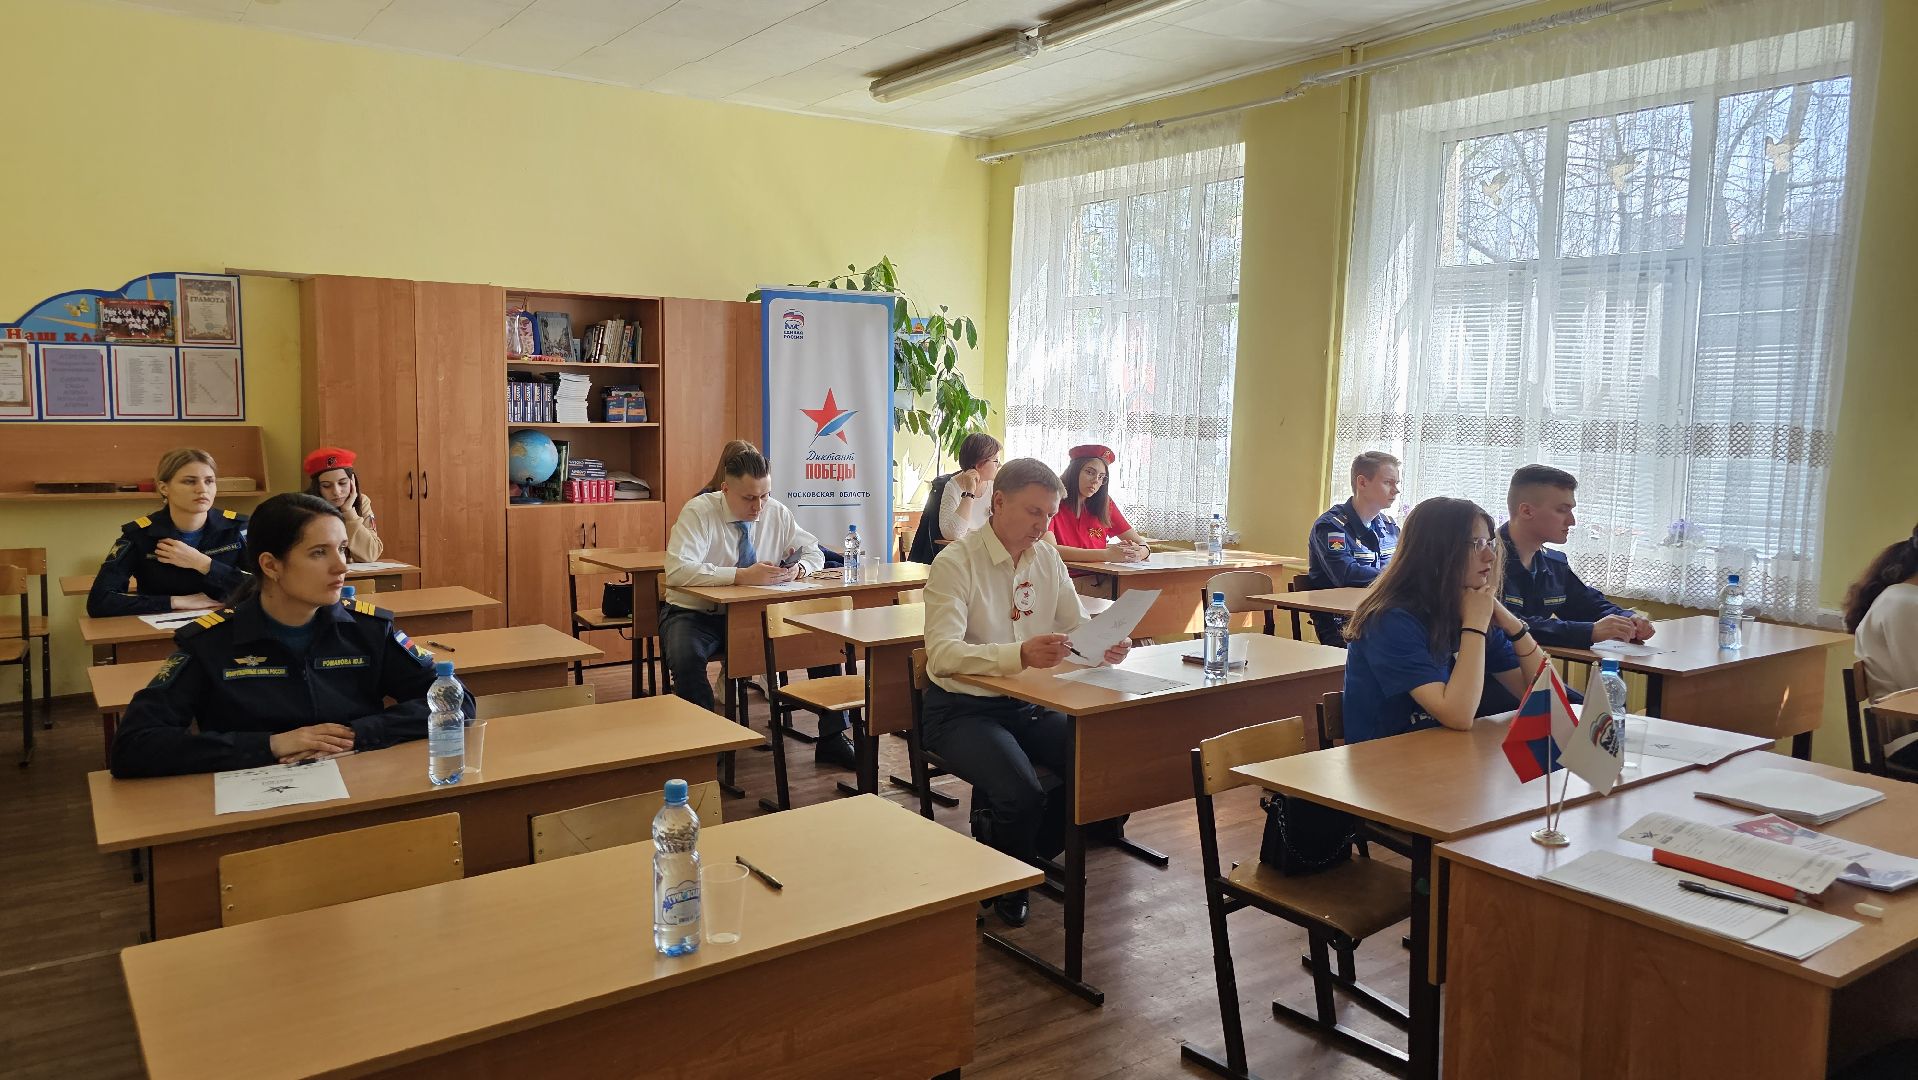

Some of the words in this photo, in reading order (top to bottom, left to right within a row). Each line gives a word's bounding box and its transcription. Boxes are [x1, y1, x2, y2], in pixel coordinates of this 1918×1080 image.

[190, 296, 225, 304] ГРАМОТА
[7, 328, 57, 341] Наш
[805, 450, 855, 461] Диктант
[805, 463, 856, 482] ПОБЕДЫ
[787, 491, 835, 499] МОСКОВСКАЯ
